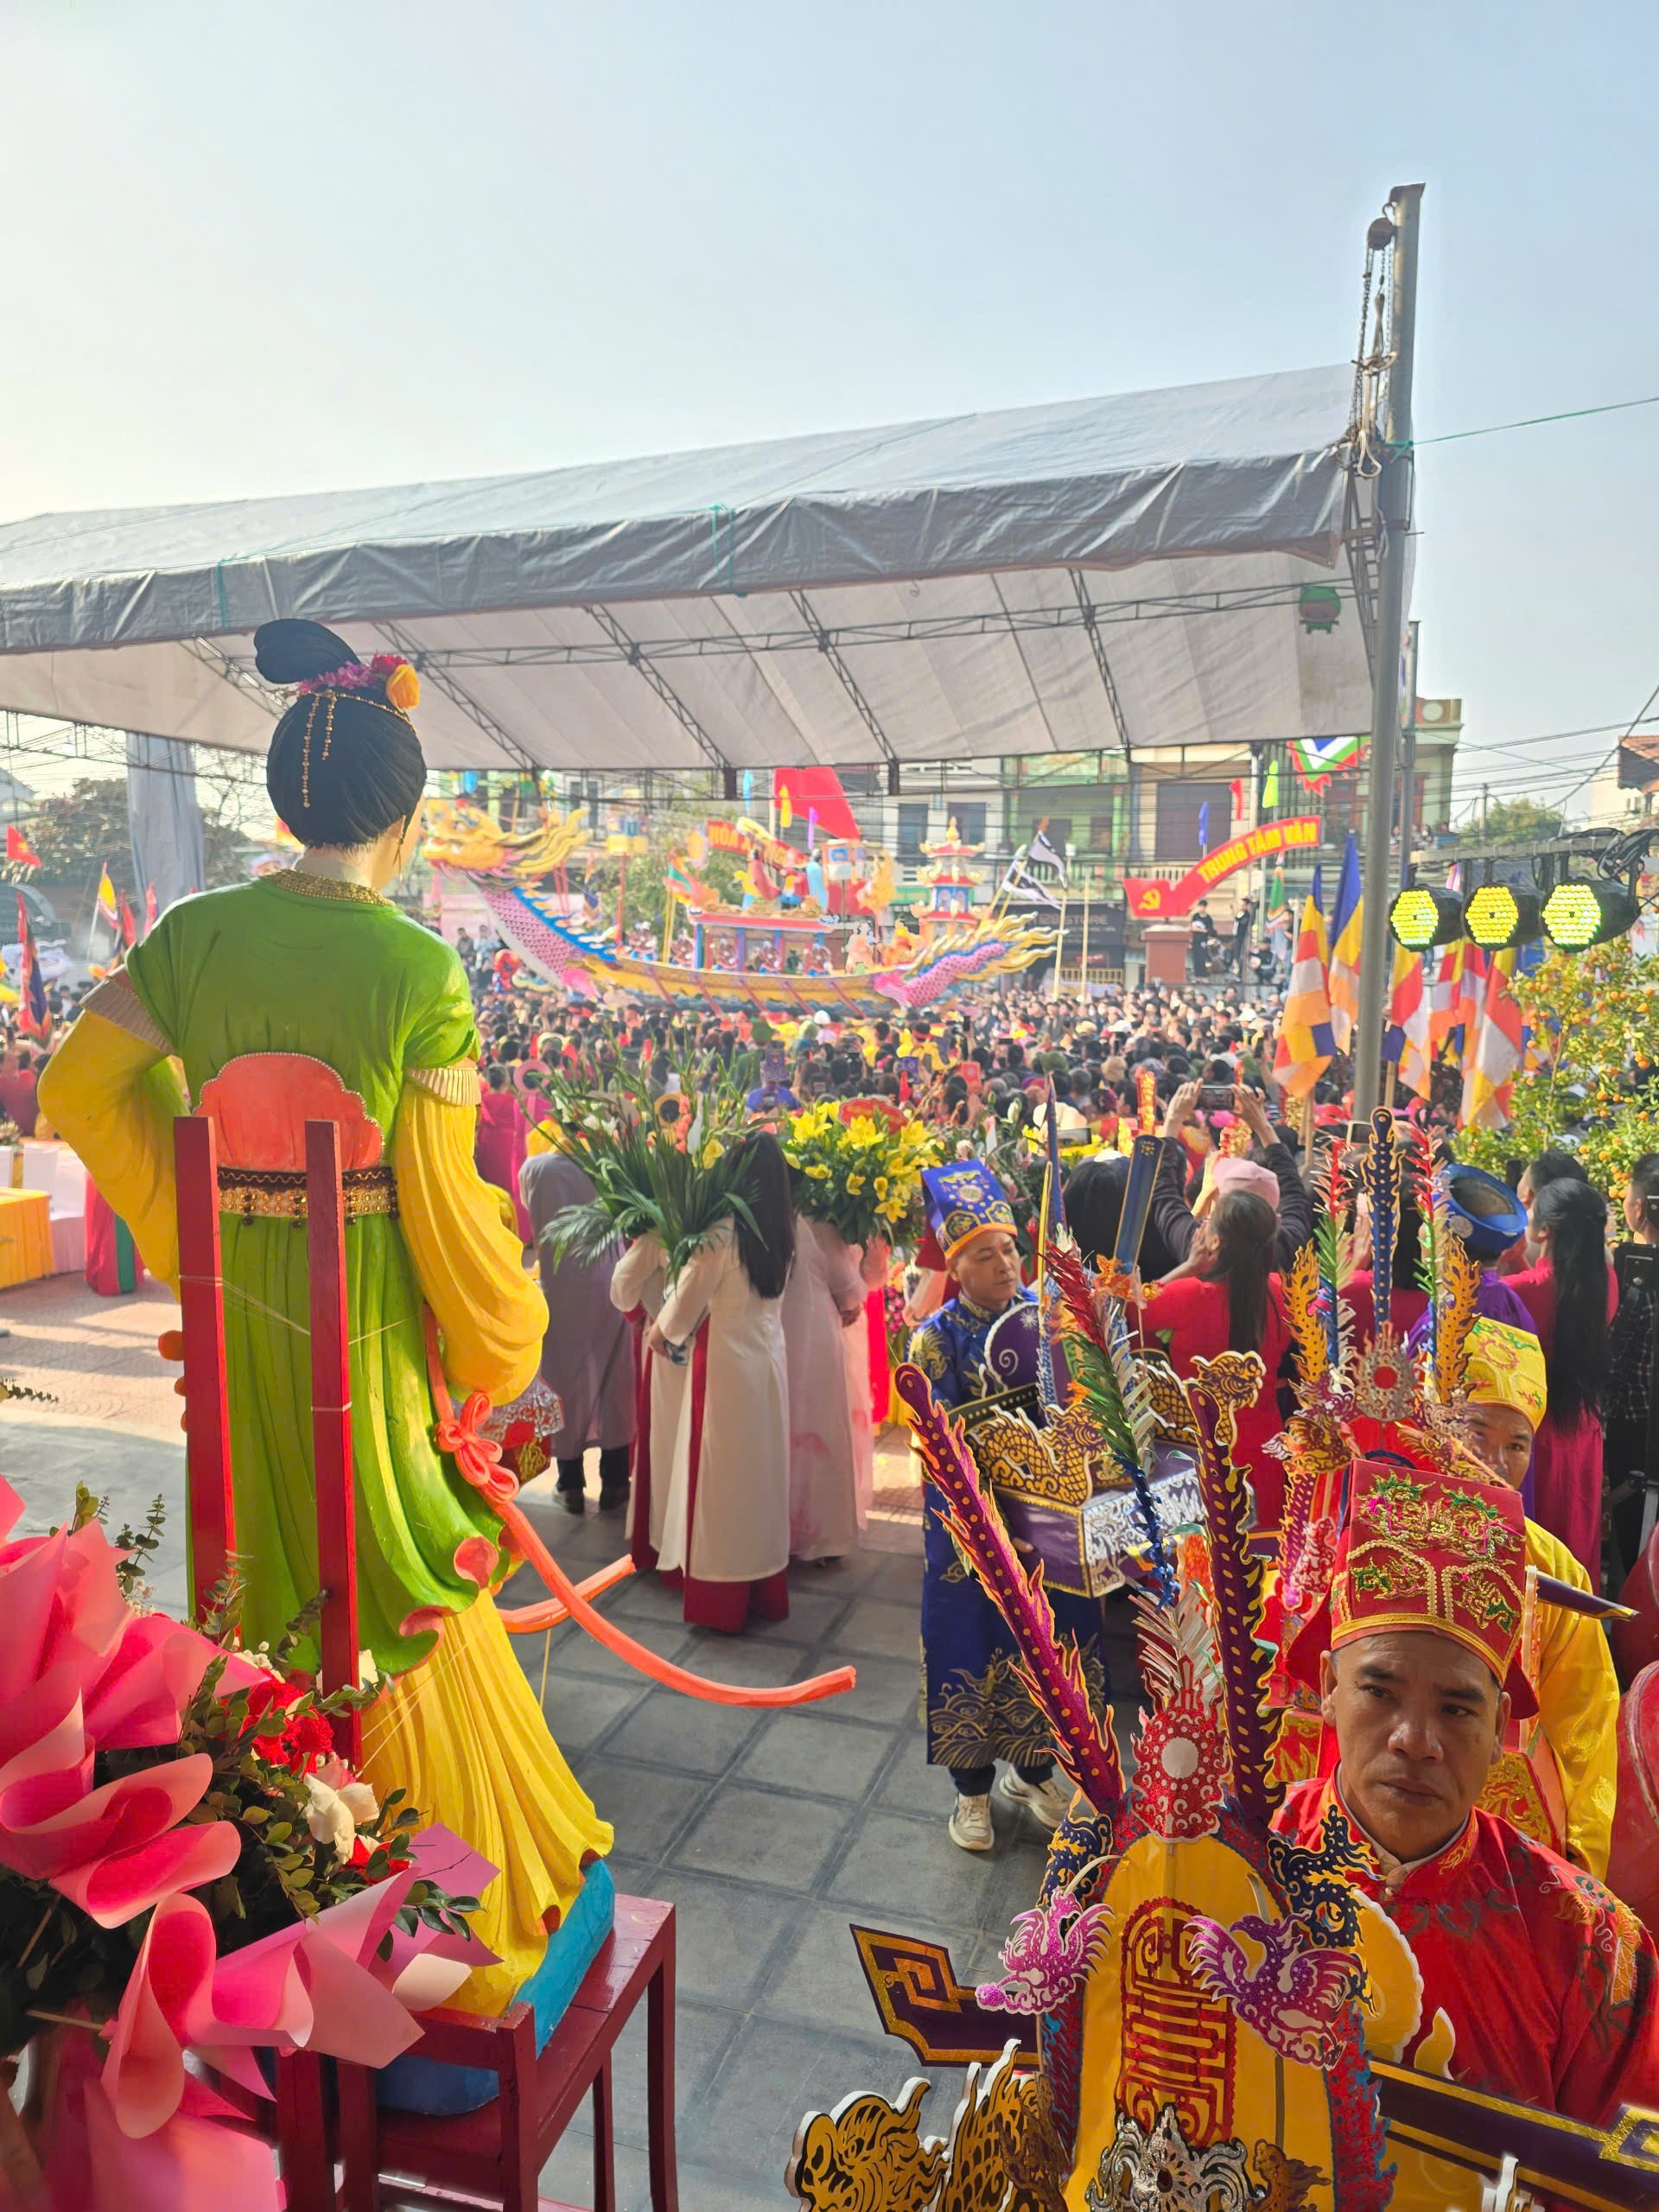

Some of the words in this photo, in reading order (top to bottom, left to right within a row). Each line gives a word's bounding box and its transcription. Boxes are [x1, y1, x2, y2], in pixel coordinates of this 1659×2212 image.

[1197, 842, 1249, 883] TRUNG
[1246, 827, 1282, 855] TÂM
[1283, 820, 1317, 844] VĂN
